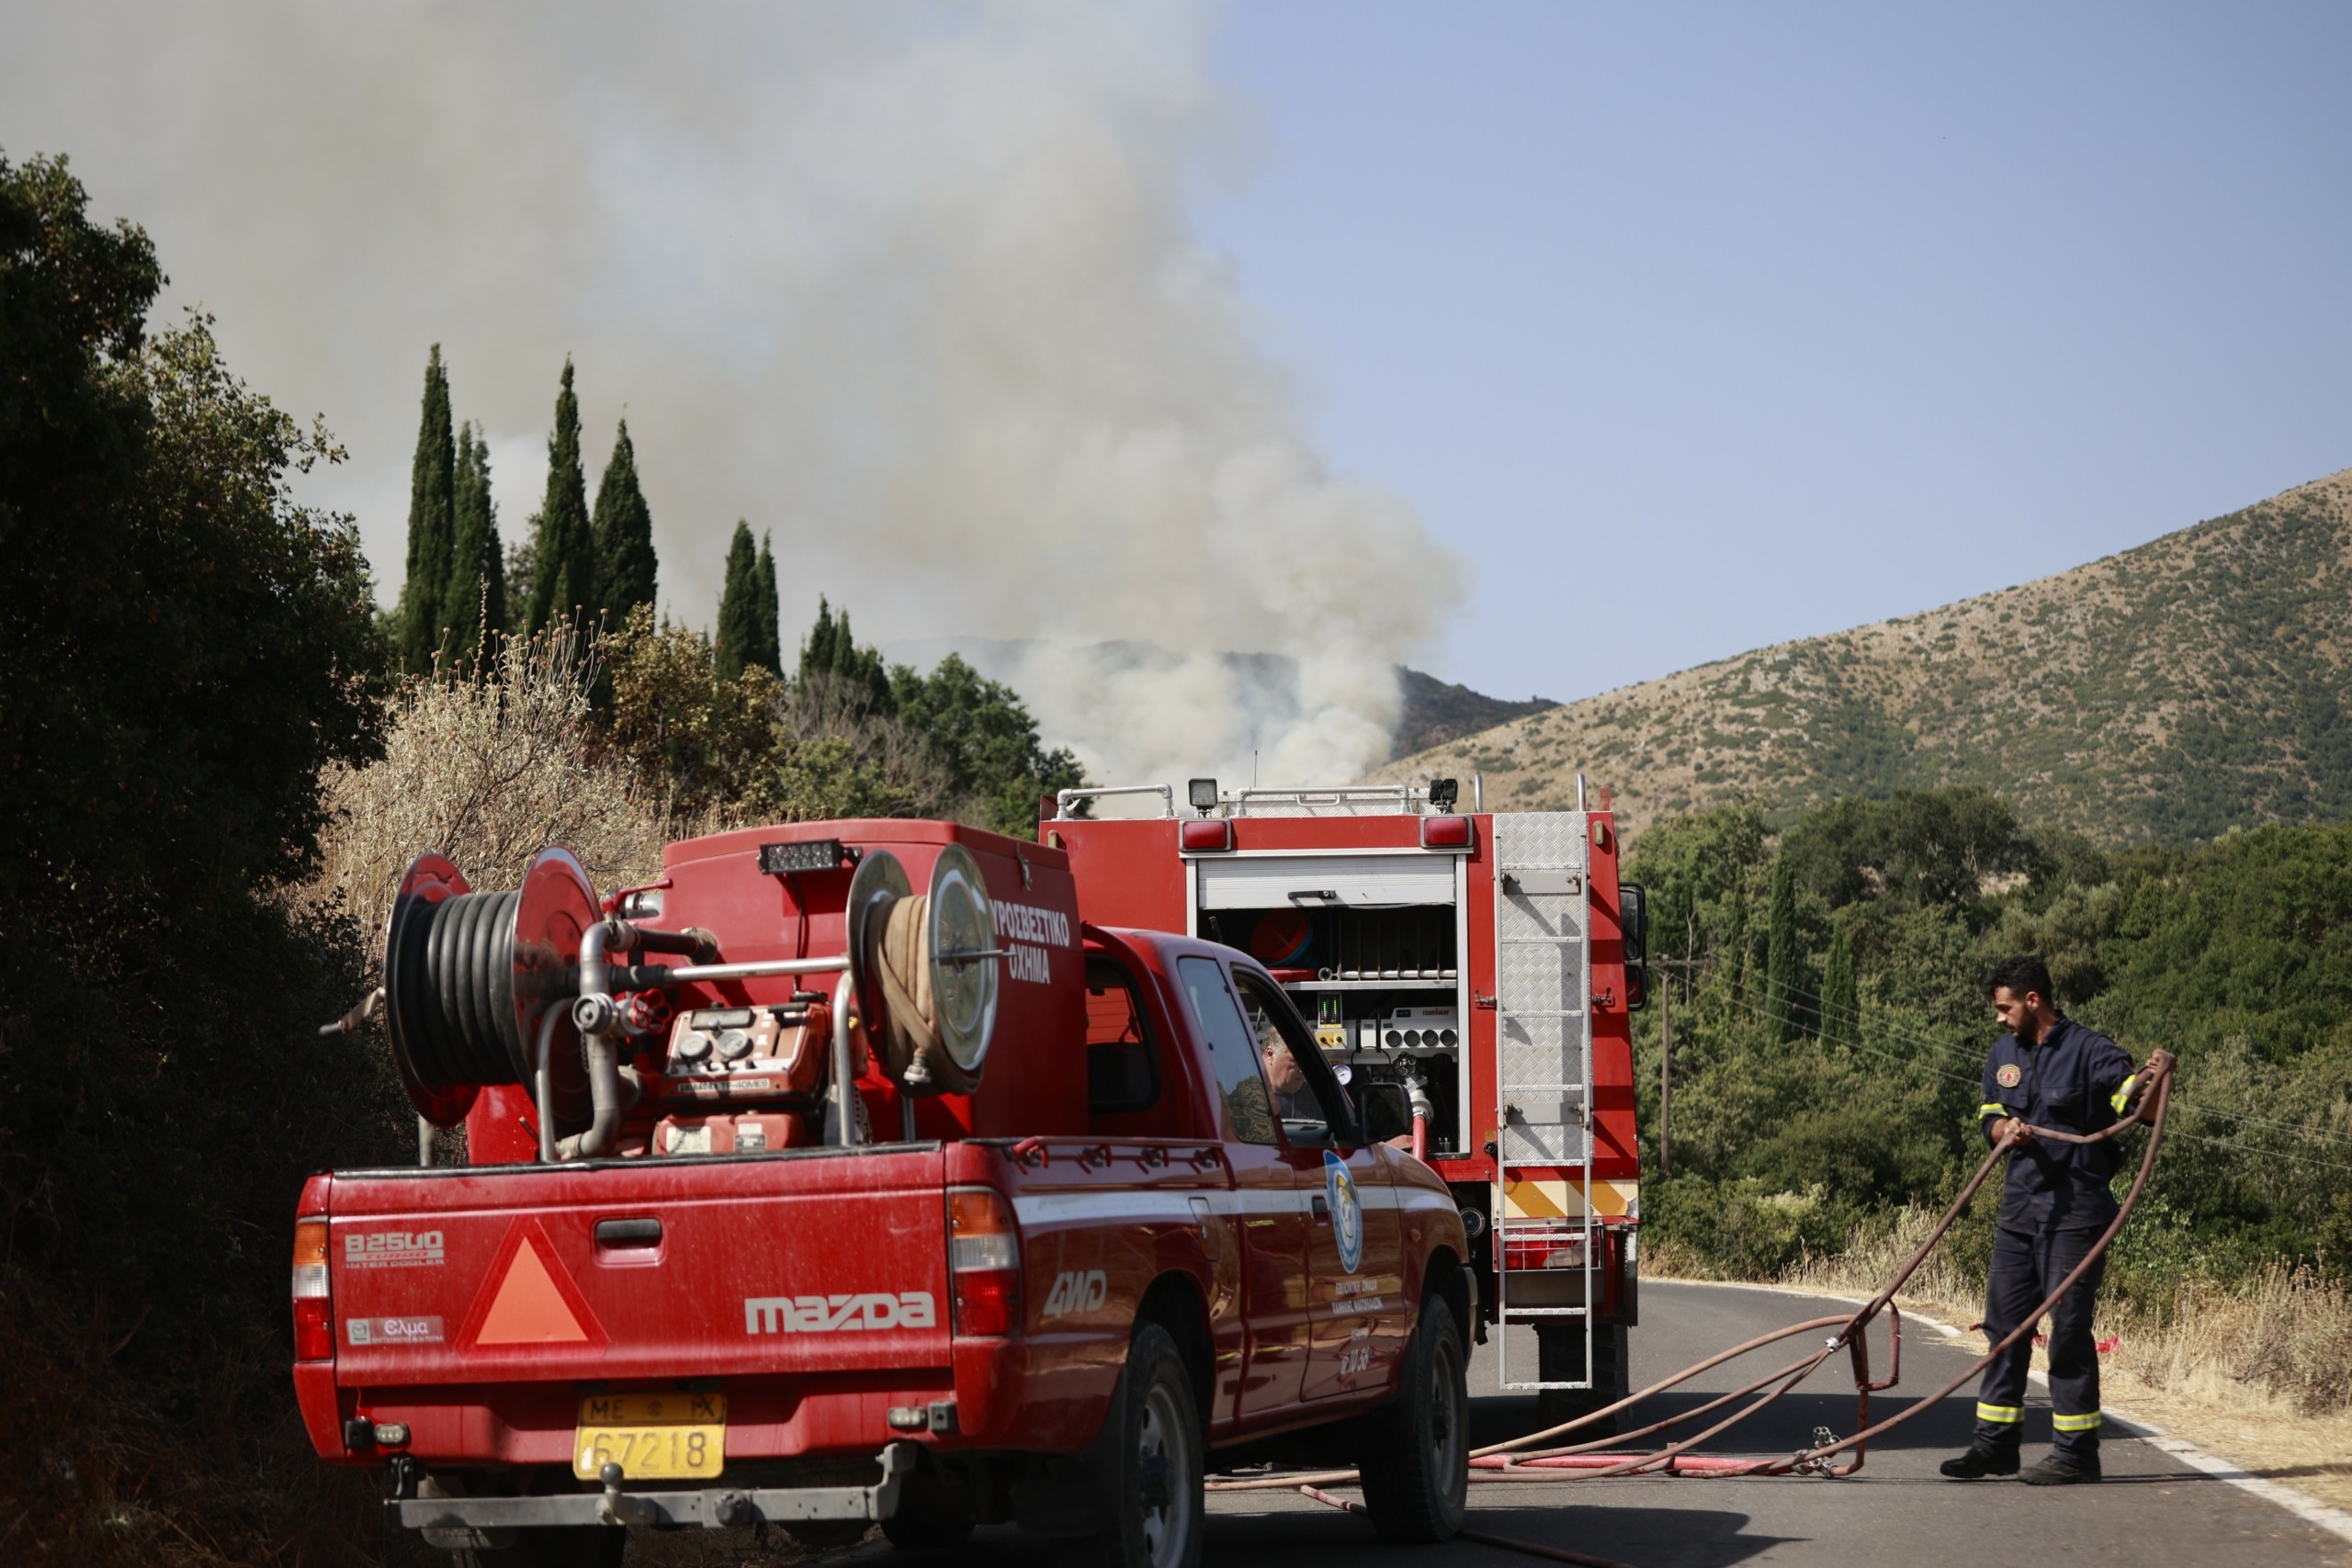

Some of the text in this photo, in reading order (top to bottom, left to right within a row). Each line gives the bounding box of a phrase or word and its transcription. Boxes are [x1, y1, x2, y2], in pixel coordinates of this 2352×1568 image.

[989, 898, 1070, 947] ΥΡΟΣΒΕΣΤΙΚΟ
[1009, 942, 1050, 985] ΟΧΗΜΑ
[345, 1231, 444, 1252] B2500
[346, 1258, 445, 1269] INTER COOLER
[1043, 1269, 1107, 1318] 4WD
[593, 1431, 706, 1469] 67218
